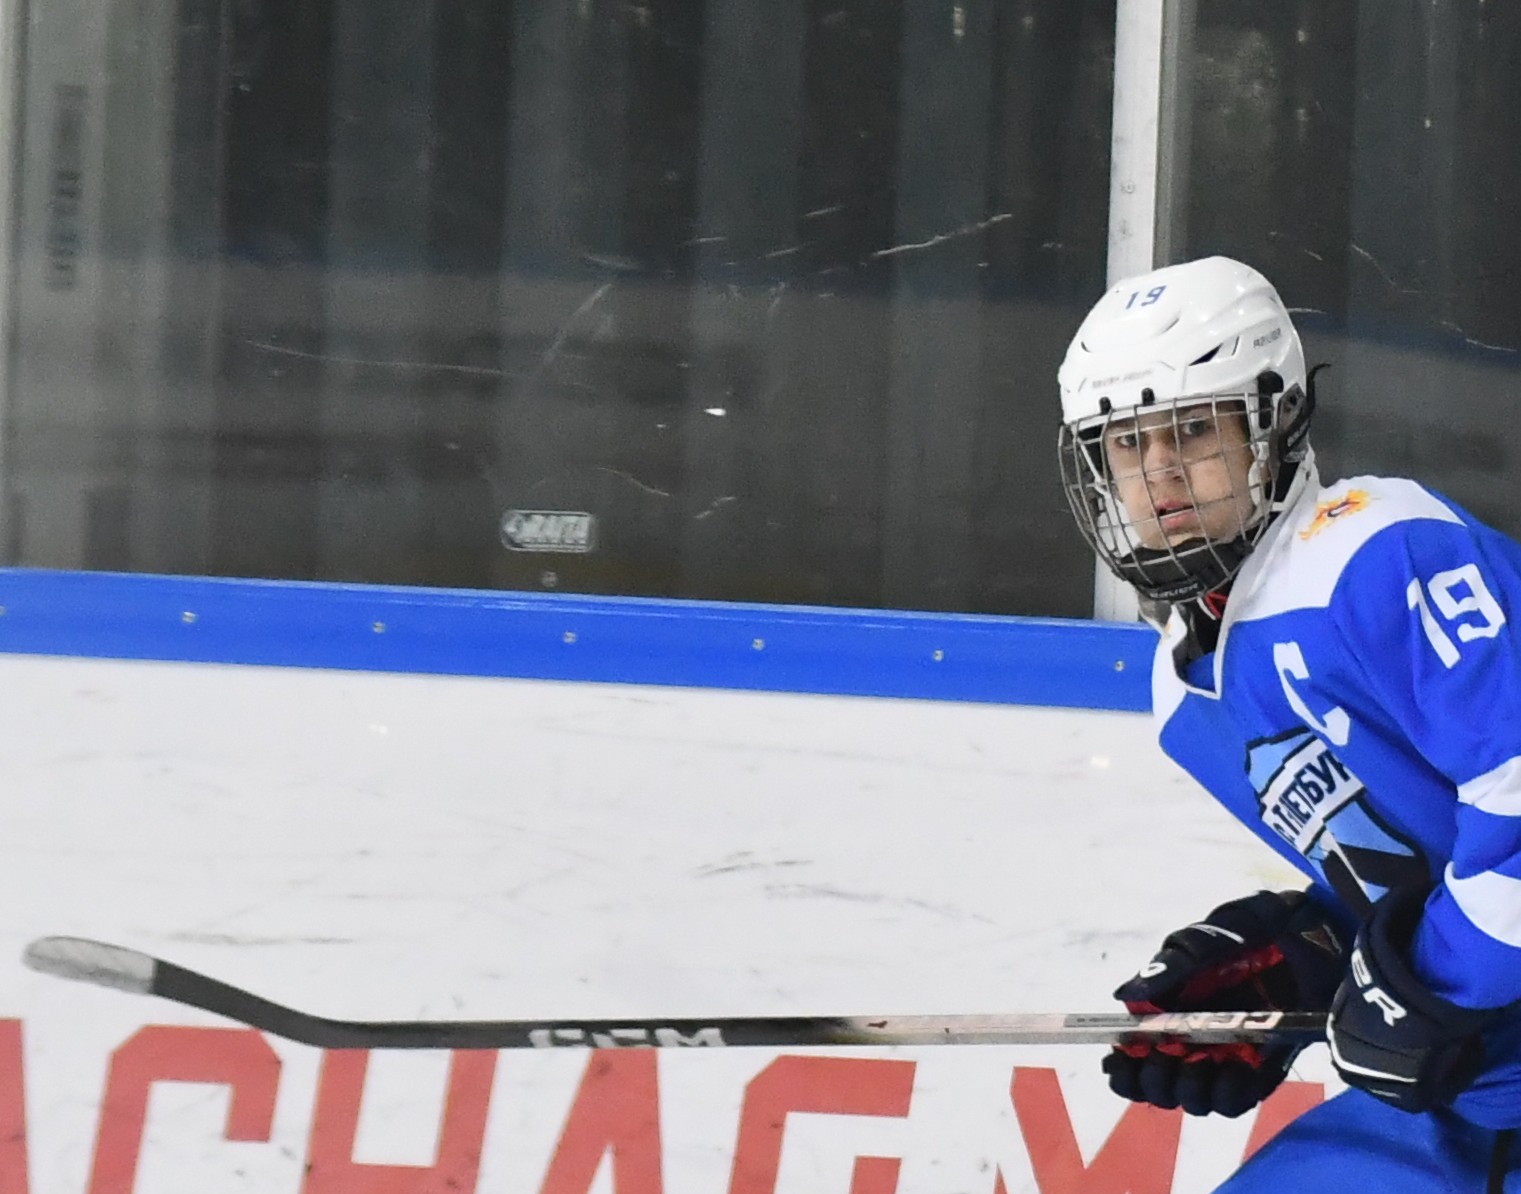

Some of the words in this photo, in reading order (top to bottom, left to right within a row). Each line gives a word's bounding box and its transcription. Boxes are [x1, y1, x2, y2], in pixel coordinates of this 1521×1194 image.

[1125, 284, 1168, 310] 19
[1406, 562, 1507, 670] 19
[1273, 641, 1350, 748] C
